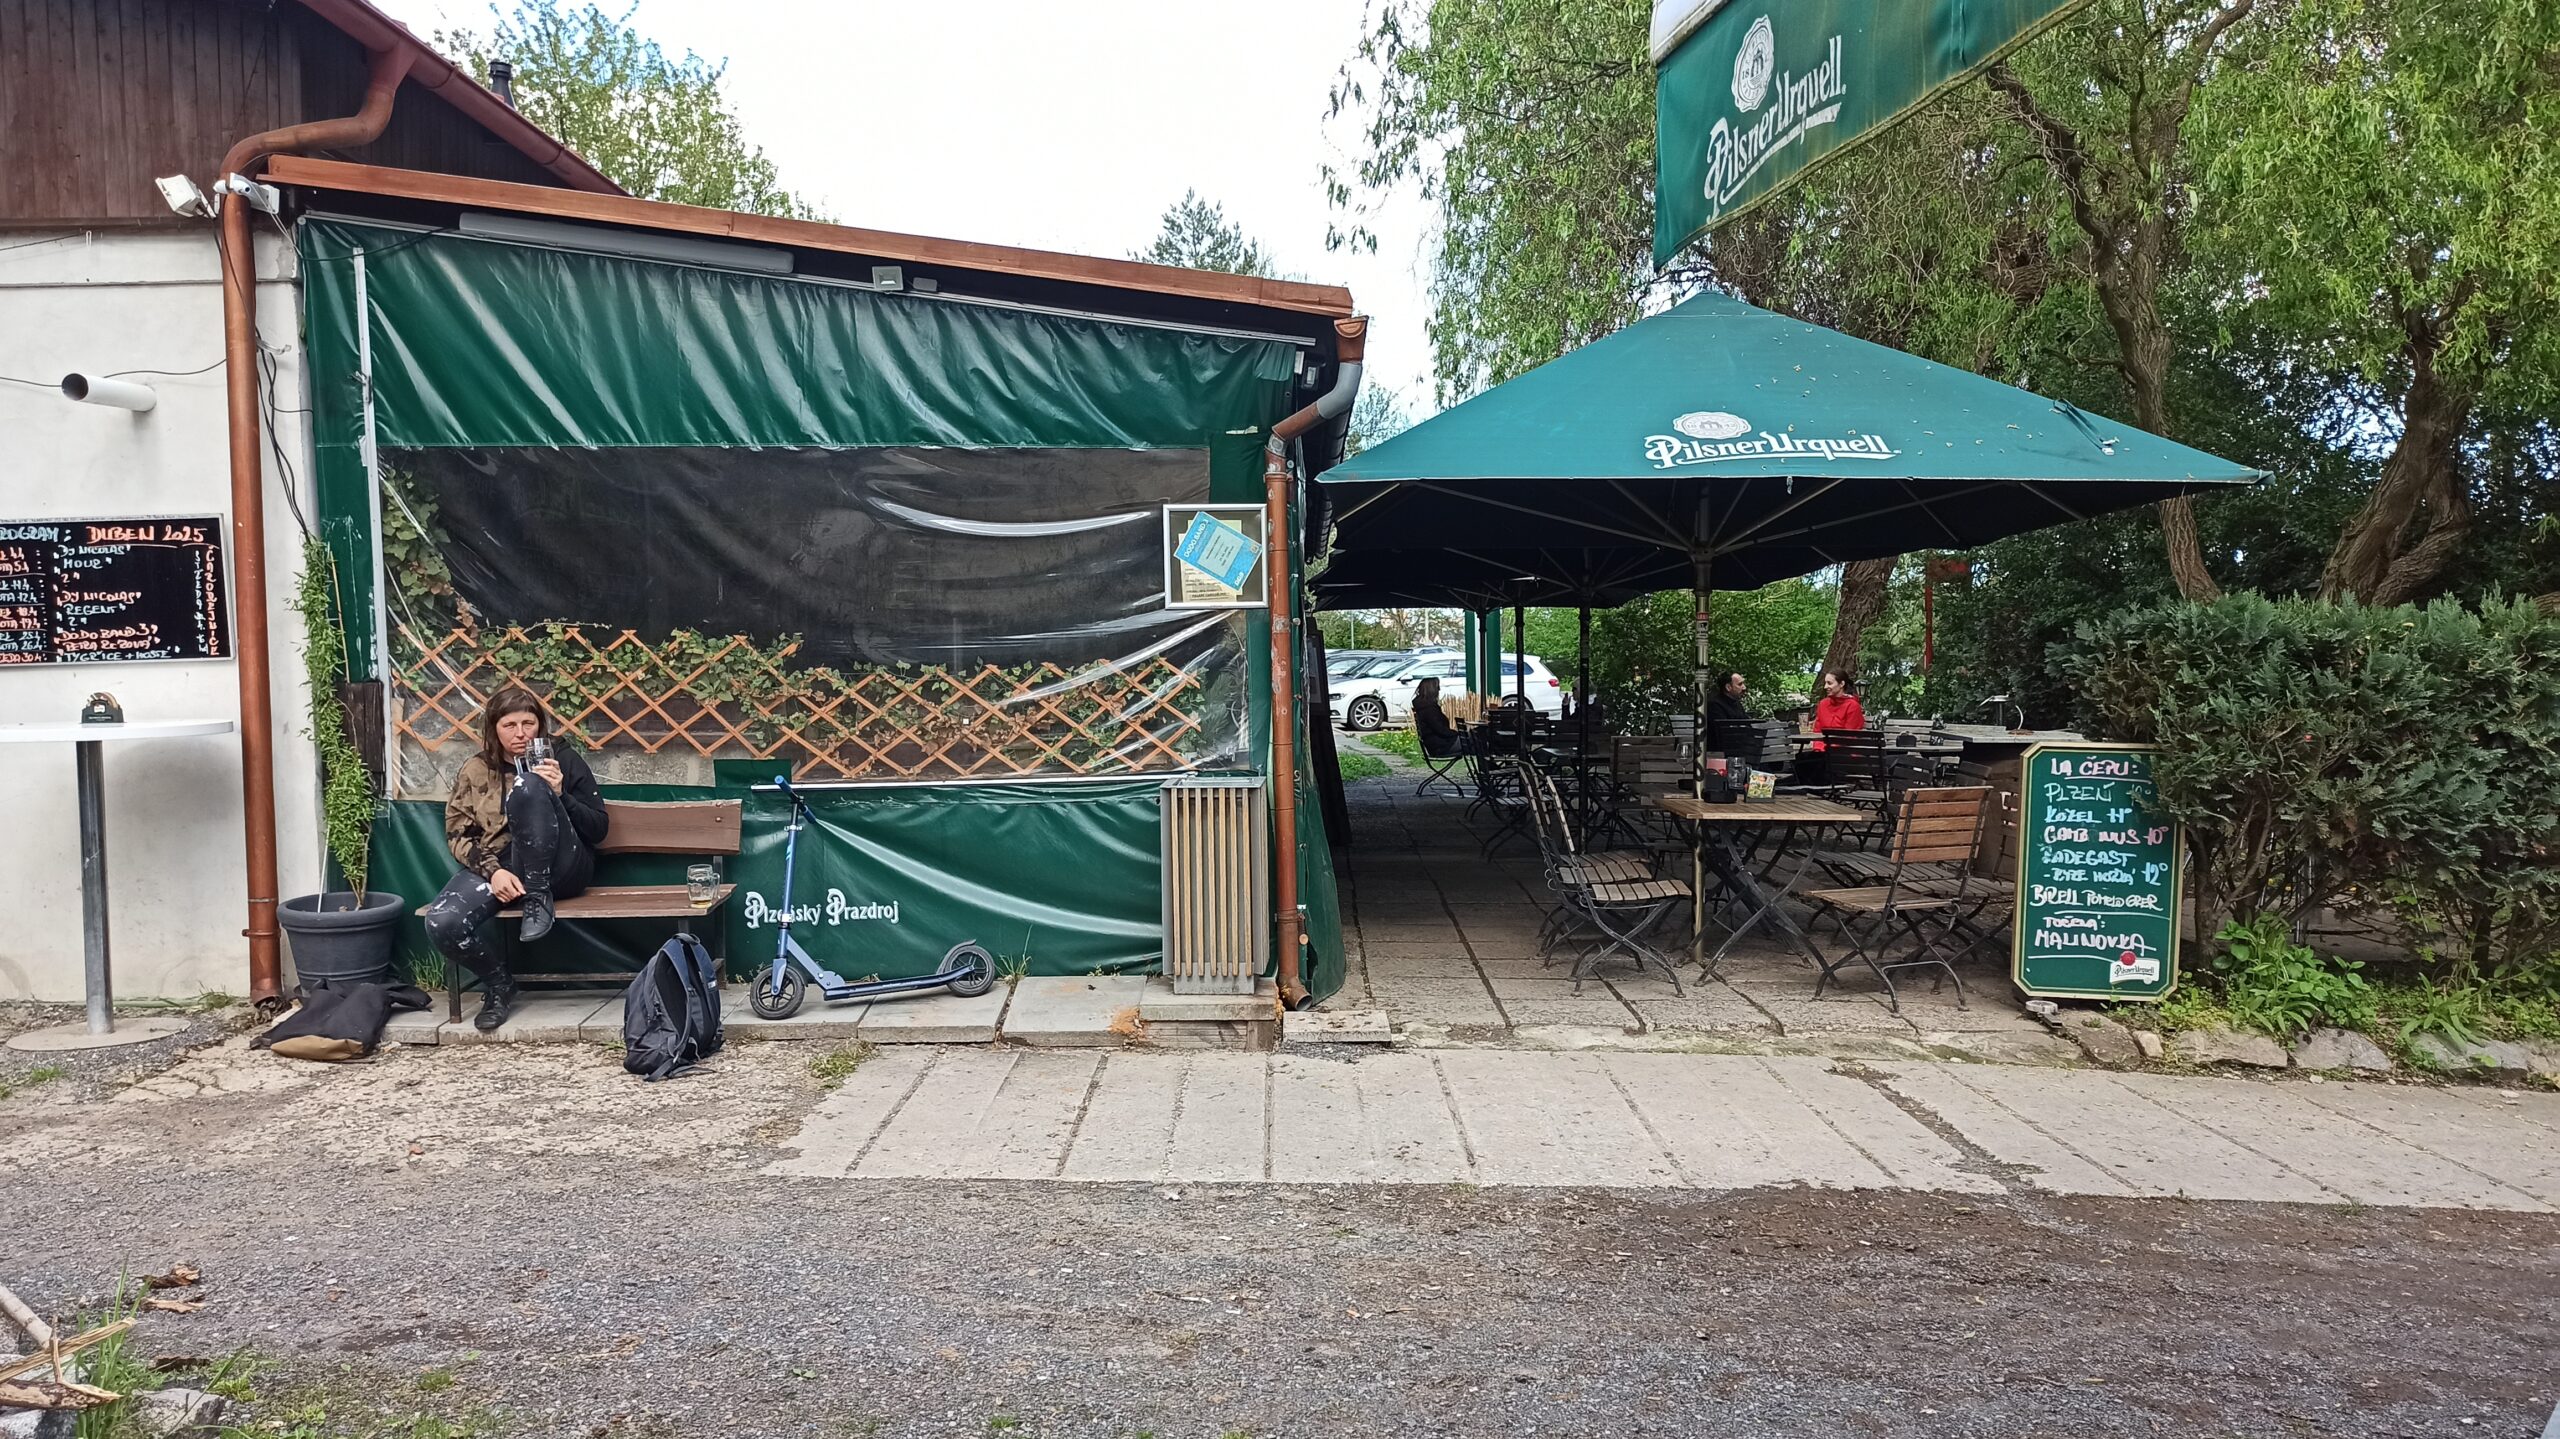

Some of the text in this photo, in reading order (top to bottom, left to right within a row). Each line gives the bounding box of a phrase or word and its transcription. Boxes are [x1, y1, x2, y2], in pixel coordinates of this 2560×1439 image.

[86, 526, 155, 544] DUBEN
[162, 525, 208, 542] 2025
[826, 888, 899, 926] Prazdroj
